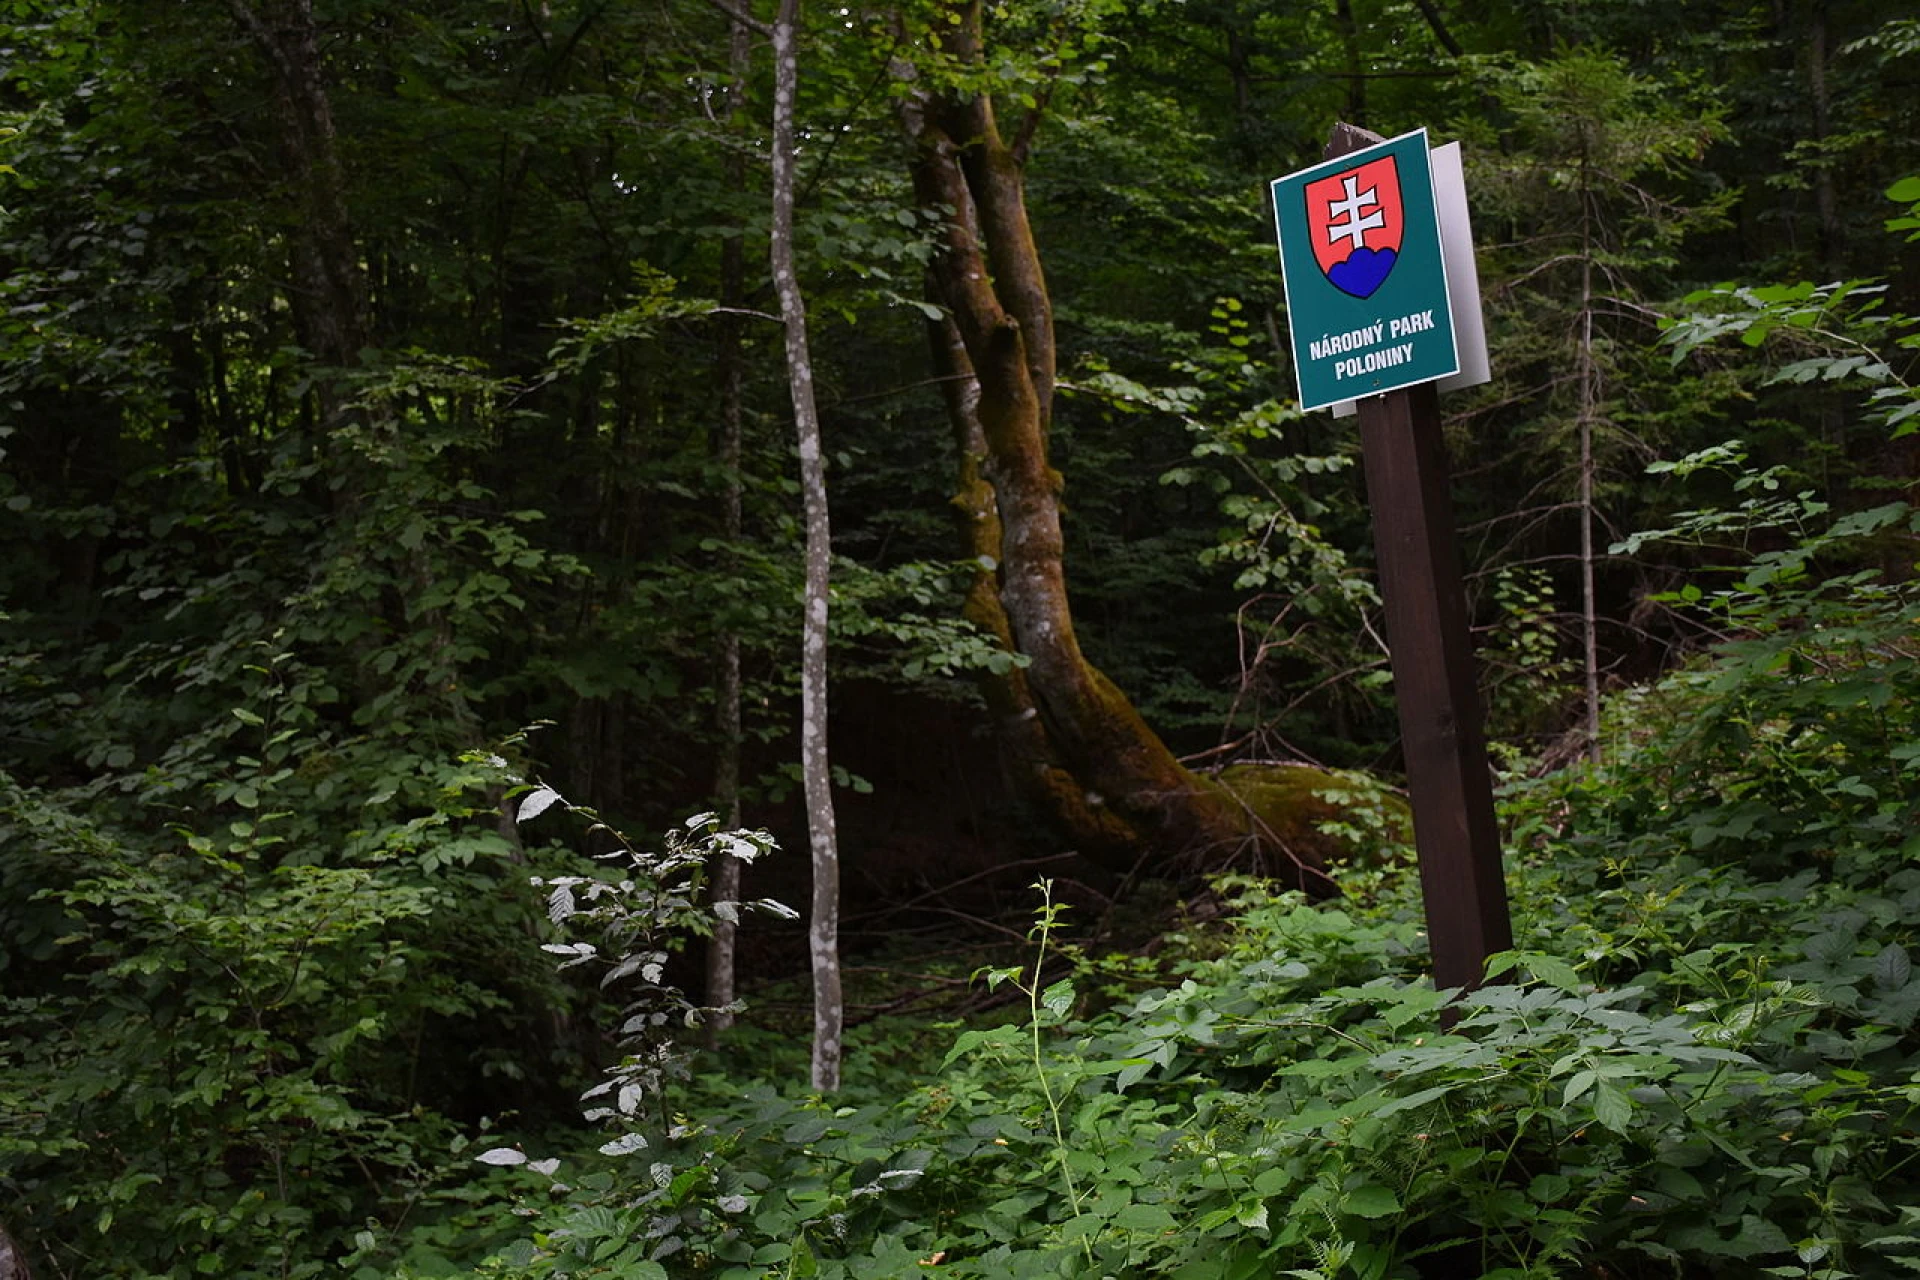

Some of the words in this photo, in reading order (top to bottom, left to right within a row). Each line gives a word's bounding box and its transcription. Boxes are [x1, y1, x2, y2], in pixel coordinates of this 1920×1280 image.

[1309, 318, 1383, 360] NÁRODNÝ
[1390, 309, 1435, 339] PARK
[1335, 342, 1413, 380] POLONINY
